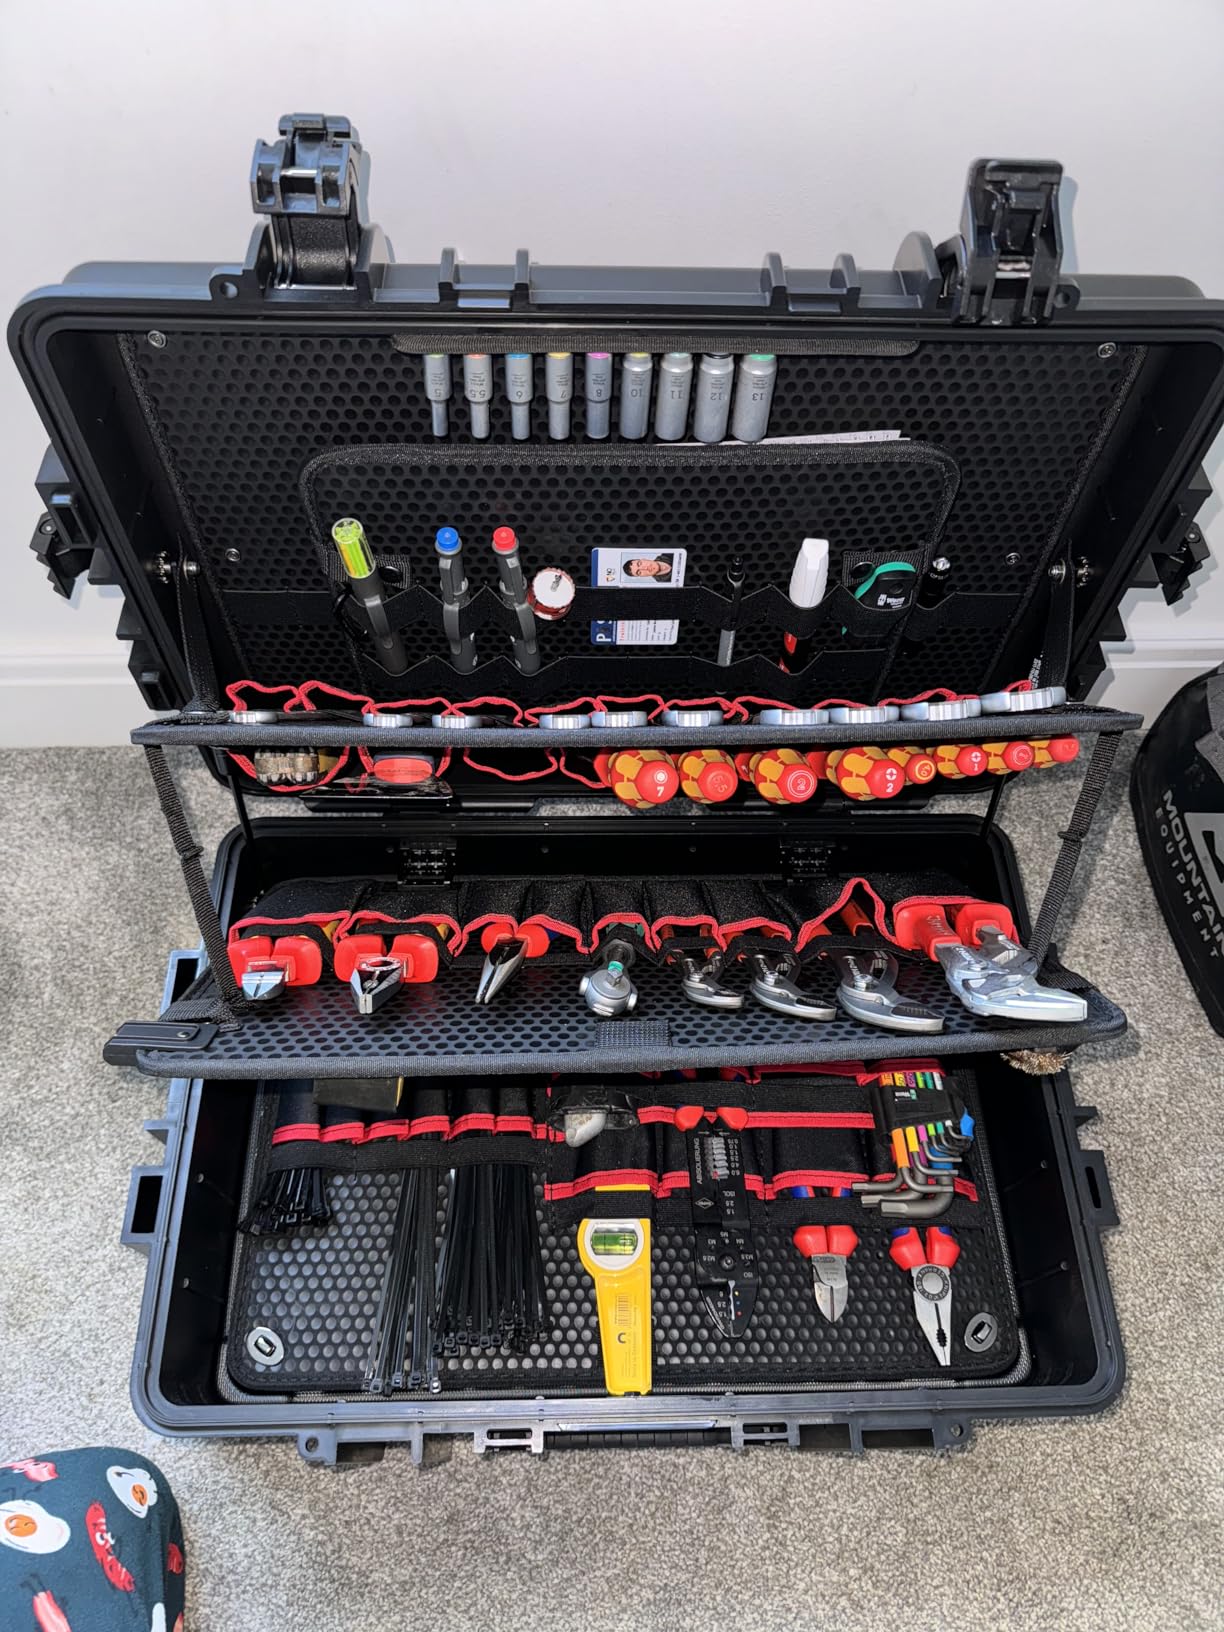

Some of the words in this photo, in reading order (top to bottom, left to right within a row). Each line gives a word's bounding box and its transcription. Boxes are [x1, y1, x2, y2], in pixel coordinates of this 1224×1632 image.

[433, 388, 442, 398] 5
[468, 389, 487, 399] 5.5
[516, 390, 524, 400] 6
[560, 389, 568, 399] 7
[595, 388, 603, 398] 8
[630, 388, 643, 398] 10
[670, 390, 683, 400] 11
[710, 392, 723, 401] 12
[751, 392, 765, 401] 13
[796, 778, 806, 791] 2
[886, 782, 894, 793] 2
[656, 786, 664, 797] 7
